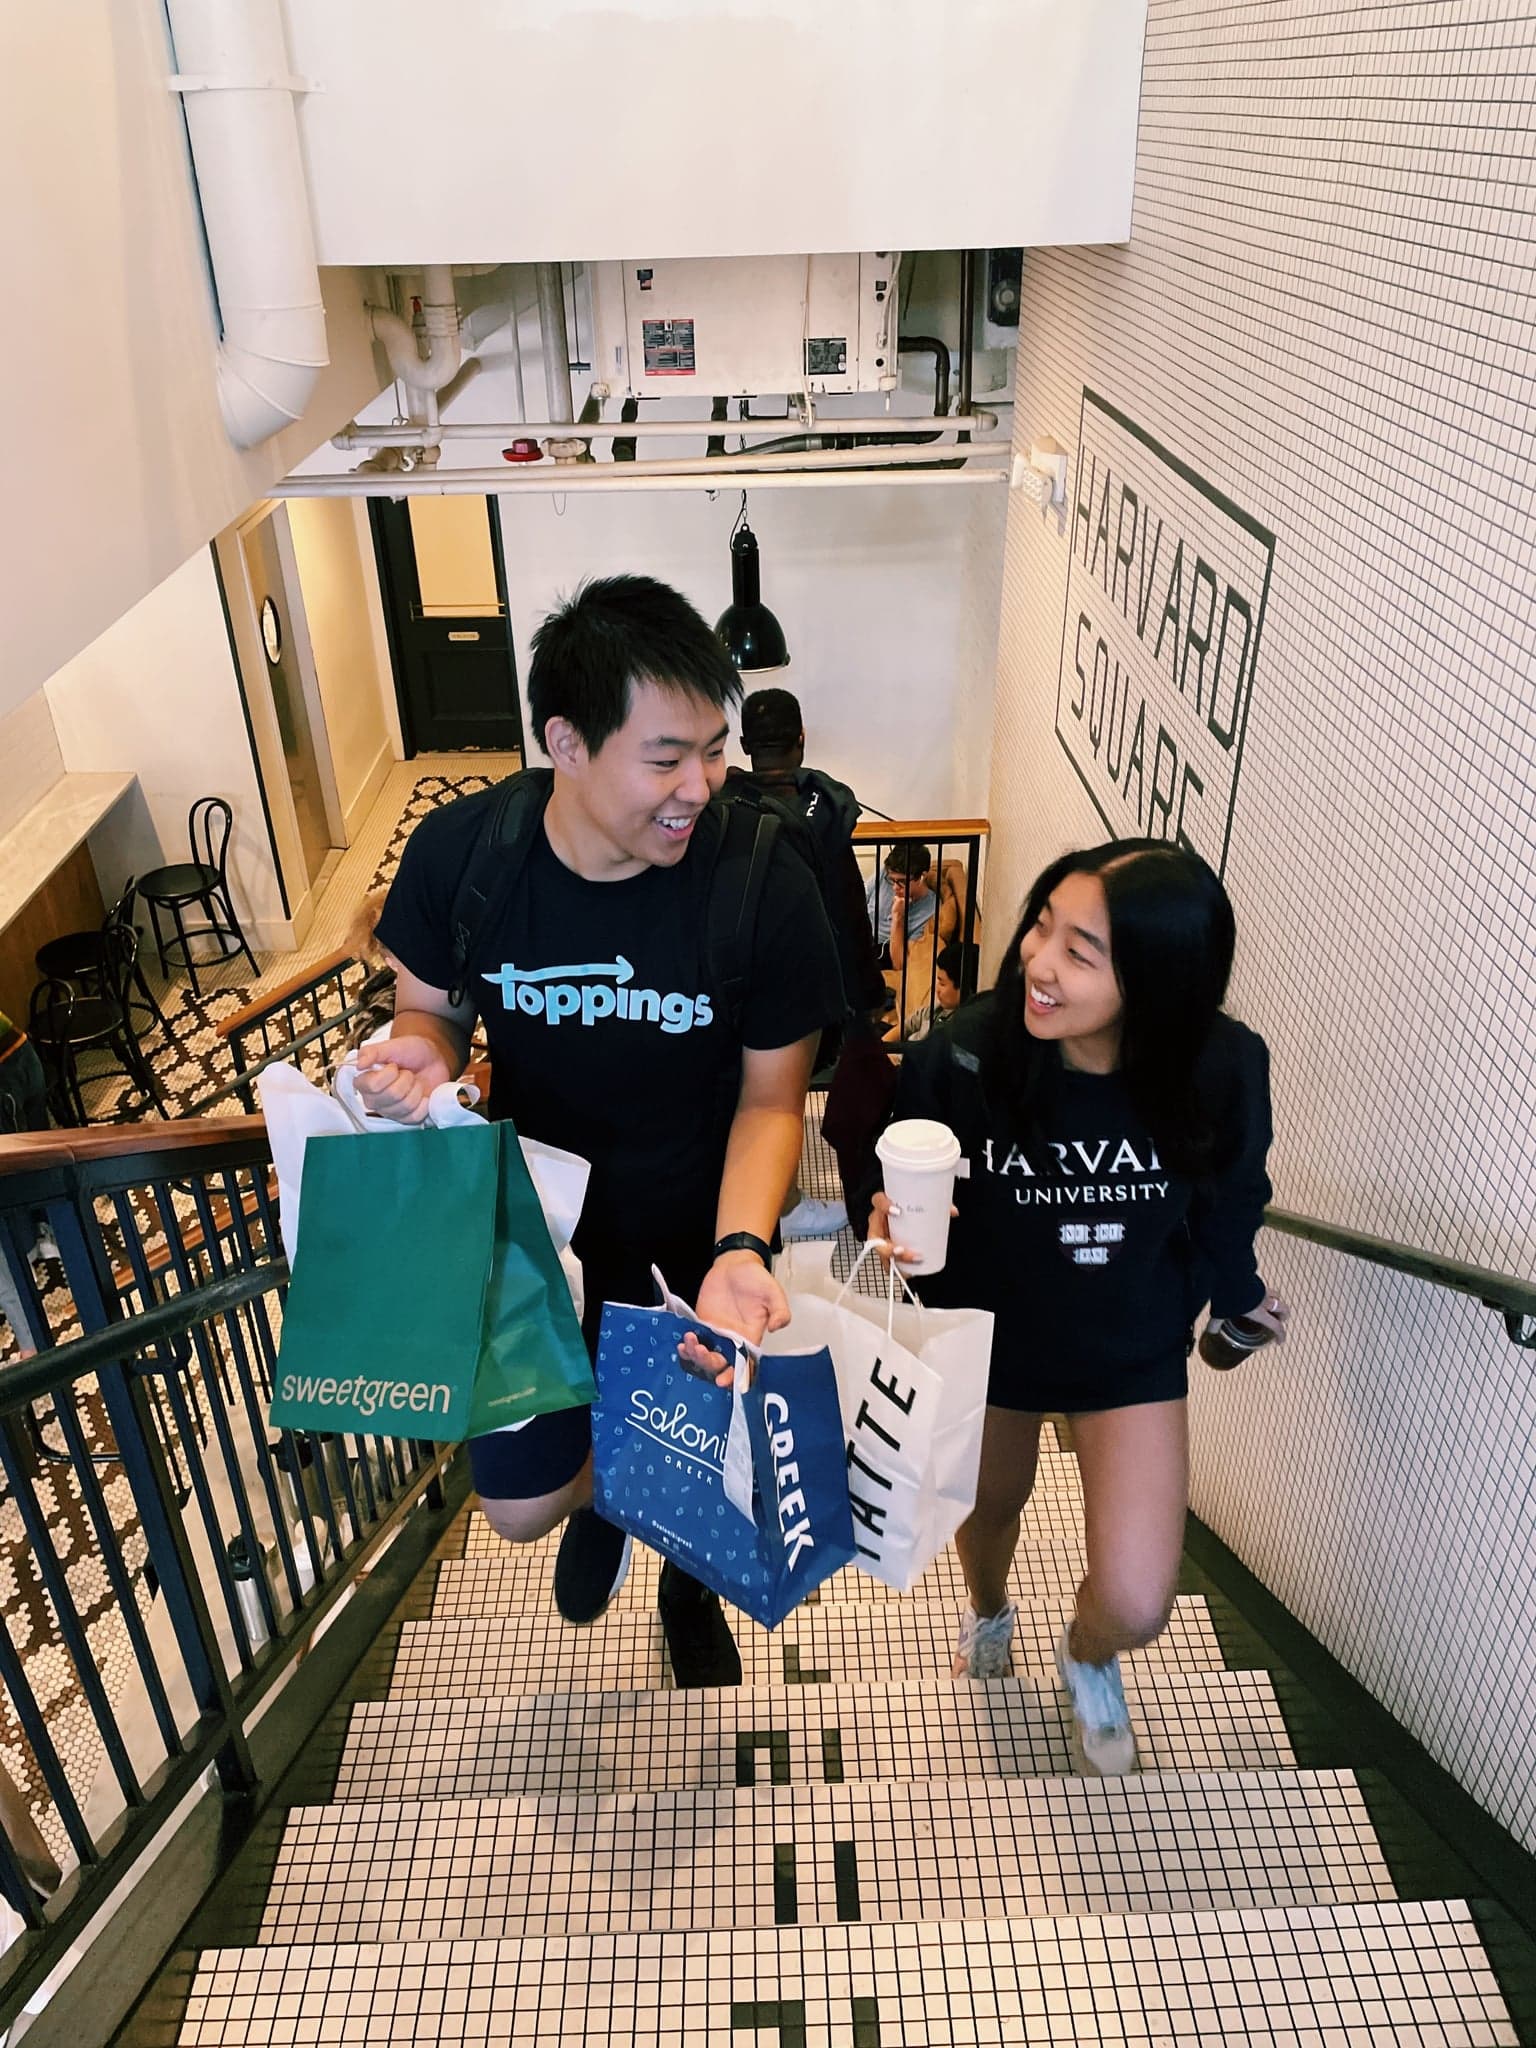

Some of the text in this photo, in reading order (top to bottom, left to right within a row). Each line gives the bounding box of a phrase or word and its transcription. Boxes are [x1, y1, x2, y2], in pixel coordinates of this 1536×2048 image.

[1073, 444, 1252, 752] HARVARD
[1015, 1181, 1169, 1205] UNIVERSITY
[281, 1374, 451, 1416] sweetgreen
